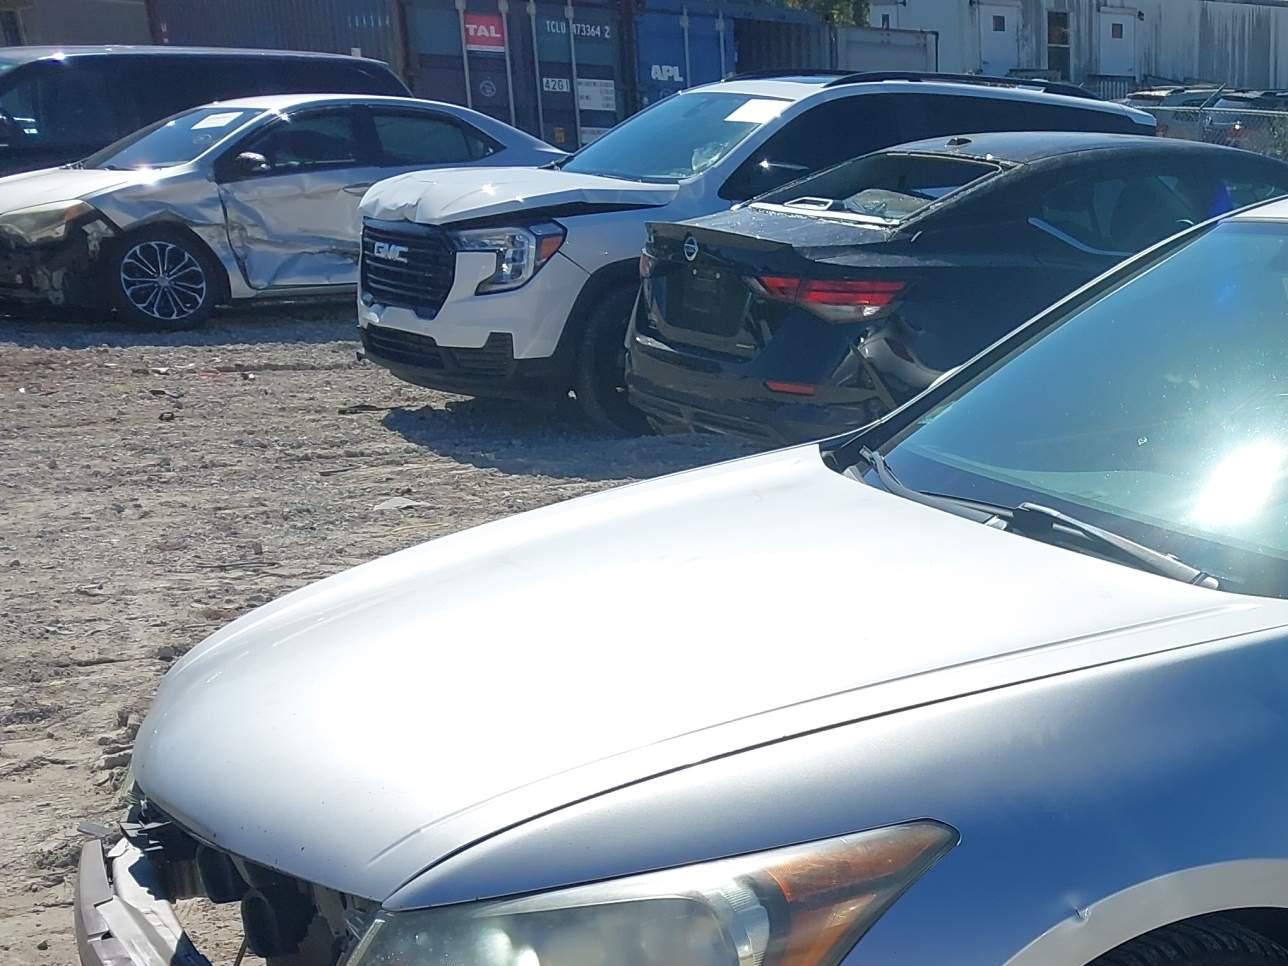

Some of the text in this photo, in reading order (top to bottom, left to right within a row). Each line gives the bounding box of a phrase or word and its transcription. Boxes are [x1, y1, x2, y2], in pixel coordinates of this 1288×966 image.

[465, 24, 501, 38] TAL
[545, 21, 567, 34] TCLU
[651, 64, 684, 81] APL
[374, 242, 409, 263] GMC
